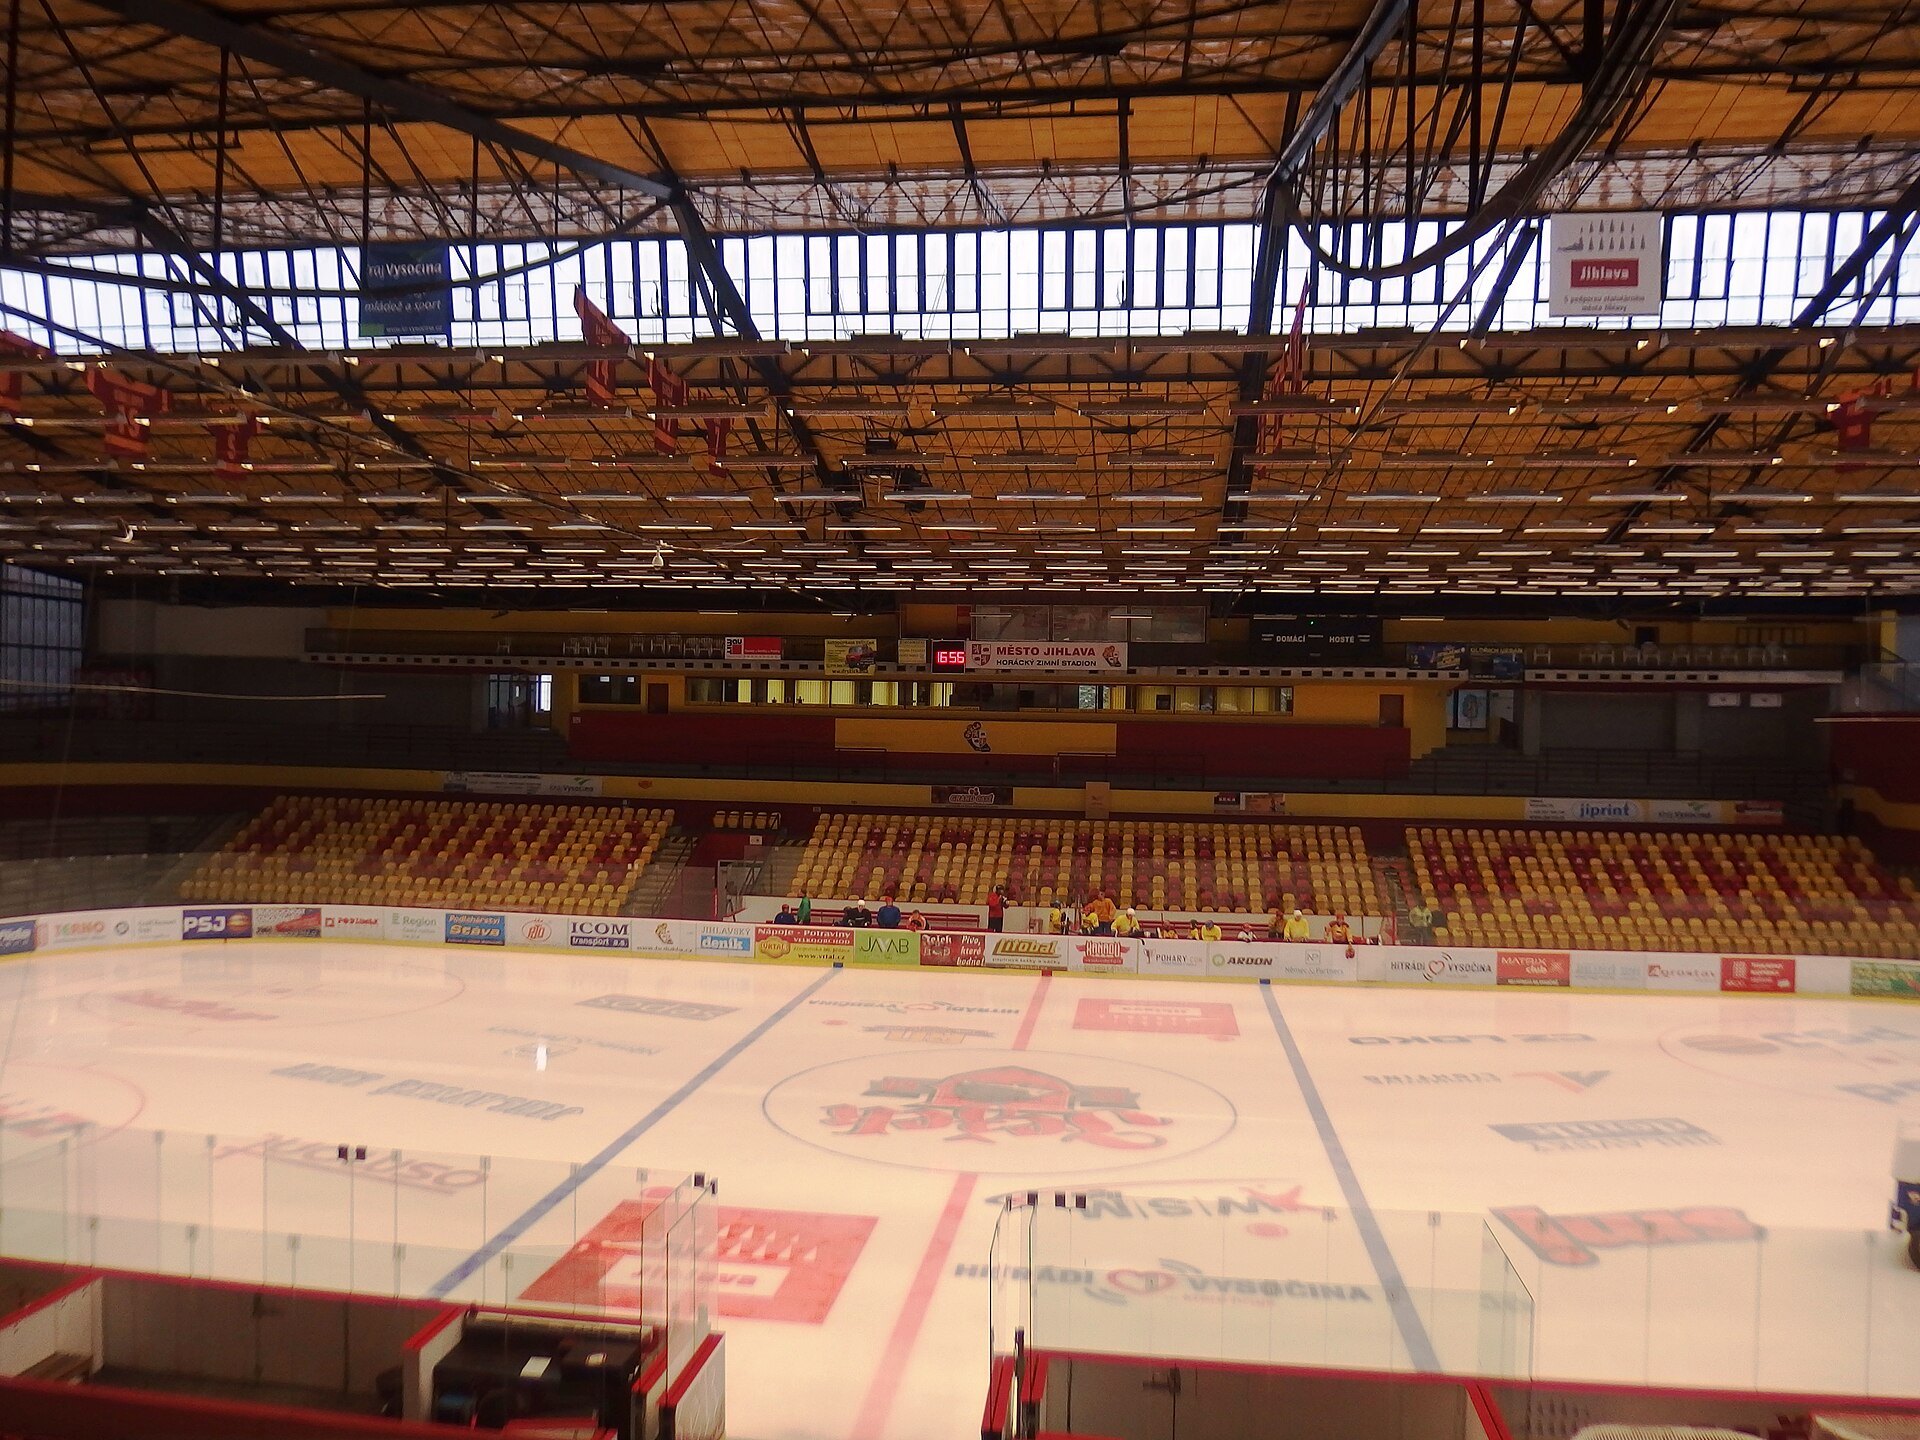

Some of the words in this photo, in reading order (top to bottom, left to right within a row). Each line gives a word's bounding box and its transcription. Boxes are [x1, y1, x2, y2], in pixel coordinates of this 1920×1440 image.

[1580, 265, 1631, 281] Jihlava
[1276, 634, 1306, 643] DOMÁCÍ
[996, 643, 1038, 657] MĚSTO
[1043, 646, 1096, 657] JIHLAVA
[996, 658, 1035, 667] HORÁCKÝ
[1036, 659, 1060, 667] ZIMNÍ
[1061, 660, 1097, 668] STADION
[1579, 800, 1630, 818] jiprint
[184, 916, 226, 933] PSJ
[403, 915, 437, 927] Region
[571, 922, 629, 935] ICOM
[758, 928, 794, 938] Nápoje
[803, 930, 851, 939] Potraviny
[572, 936, 610, 948] transport
[994, 938, 1058, 955] Litobal
[1227, 956, 1273, 966] ARDON
[1501, 956, 1547, 967] MATRIX
[1448, 962, 1492, 973] VYSOČINA
[1526, 965, 1547, 974] club
[1349, 1034, 1506, 1045] LOKO
[1189, 1276, 1374, 1302] VYSOČINA
